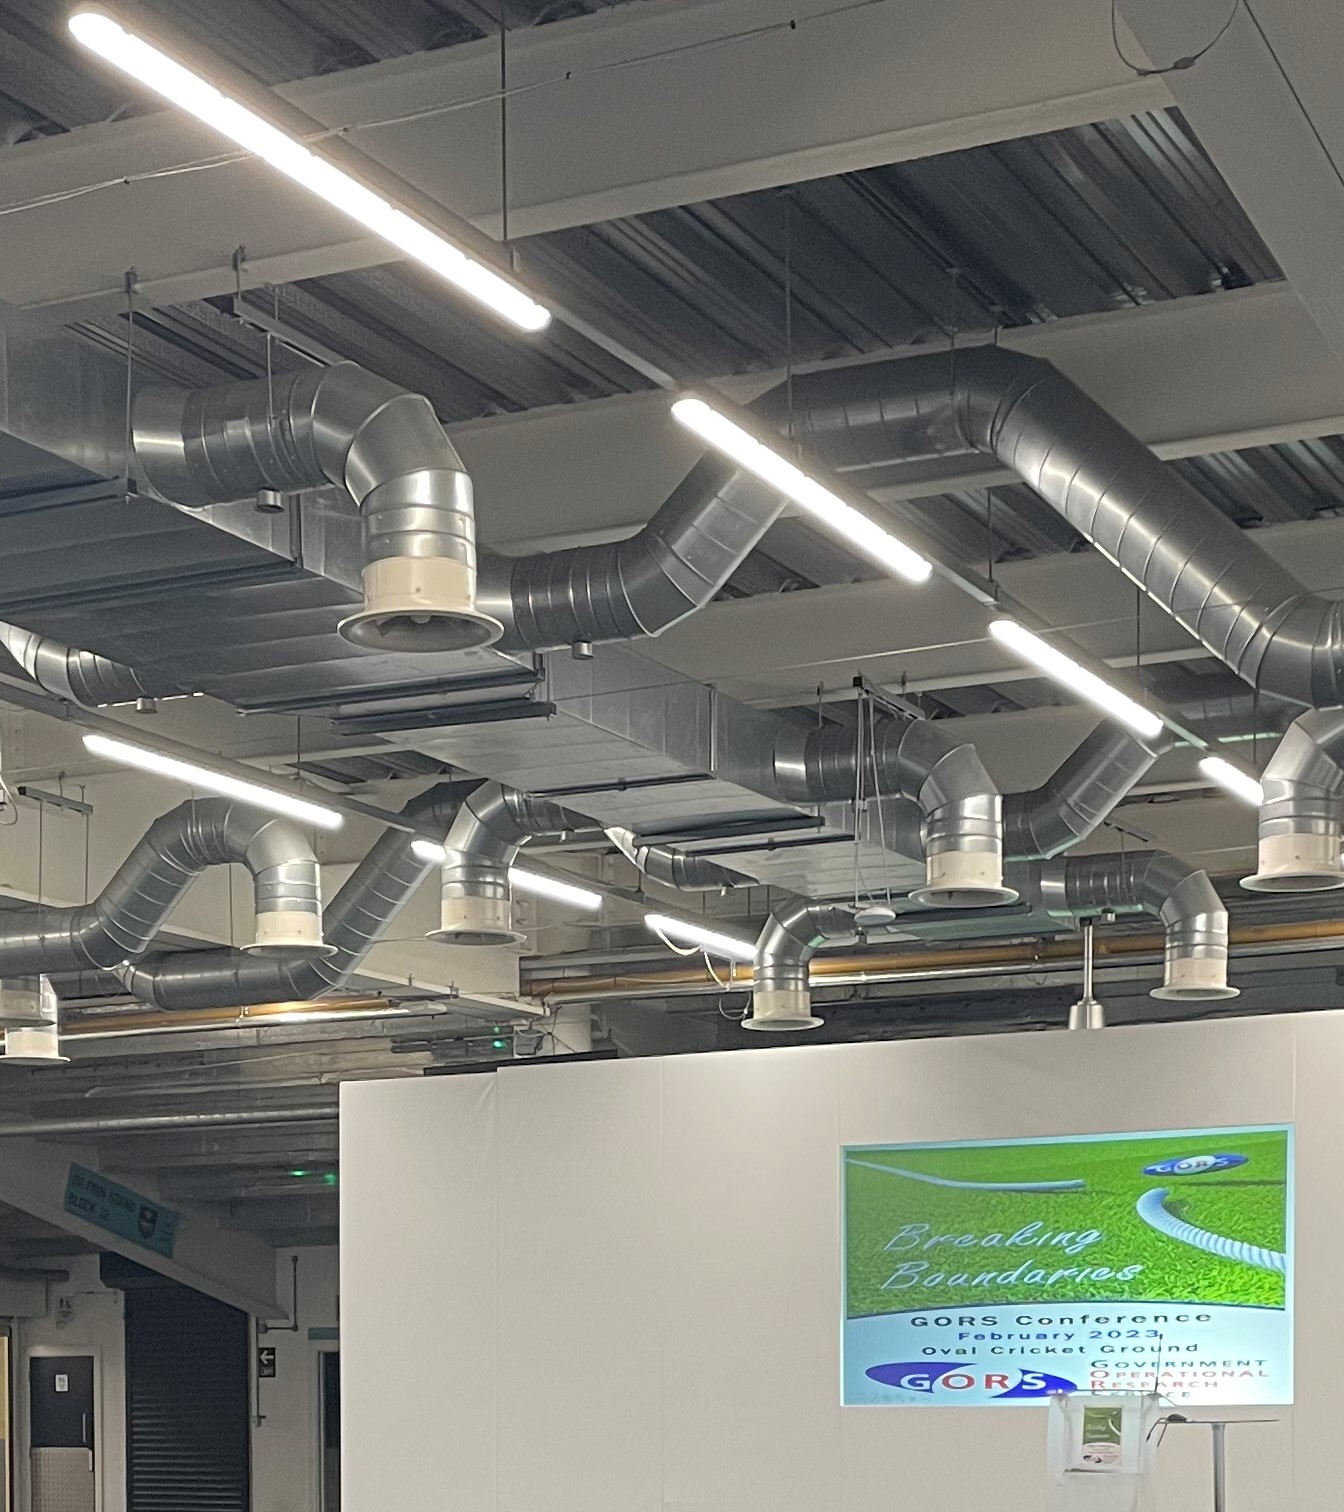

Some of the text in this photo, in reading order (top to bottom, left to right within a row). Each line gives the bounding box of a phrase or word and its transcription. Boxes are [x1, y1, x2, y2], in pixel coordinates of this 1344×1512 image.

[881, 1220, 1104, 1256] Breaking
[880, 1259, 1145, 1291] Boundaries
[910, 1312, 1213, 1328] GORS Conference
[958, 1329, 1160, 1343] February 2023
[921, 1342, 1199, 1357] Oval Cricket Ground
[900, 1372, 1047, 1391] GORS
